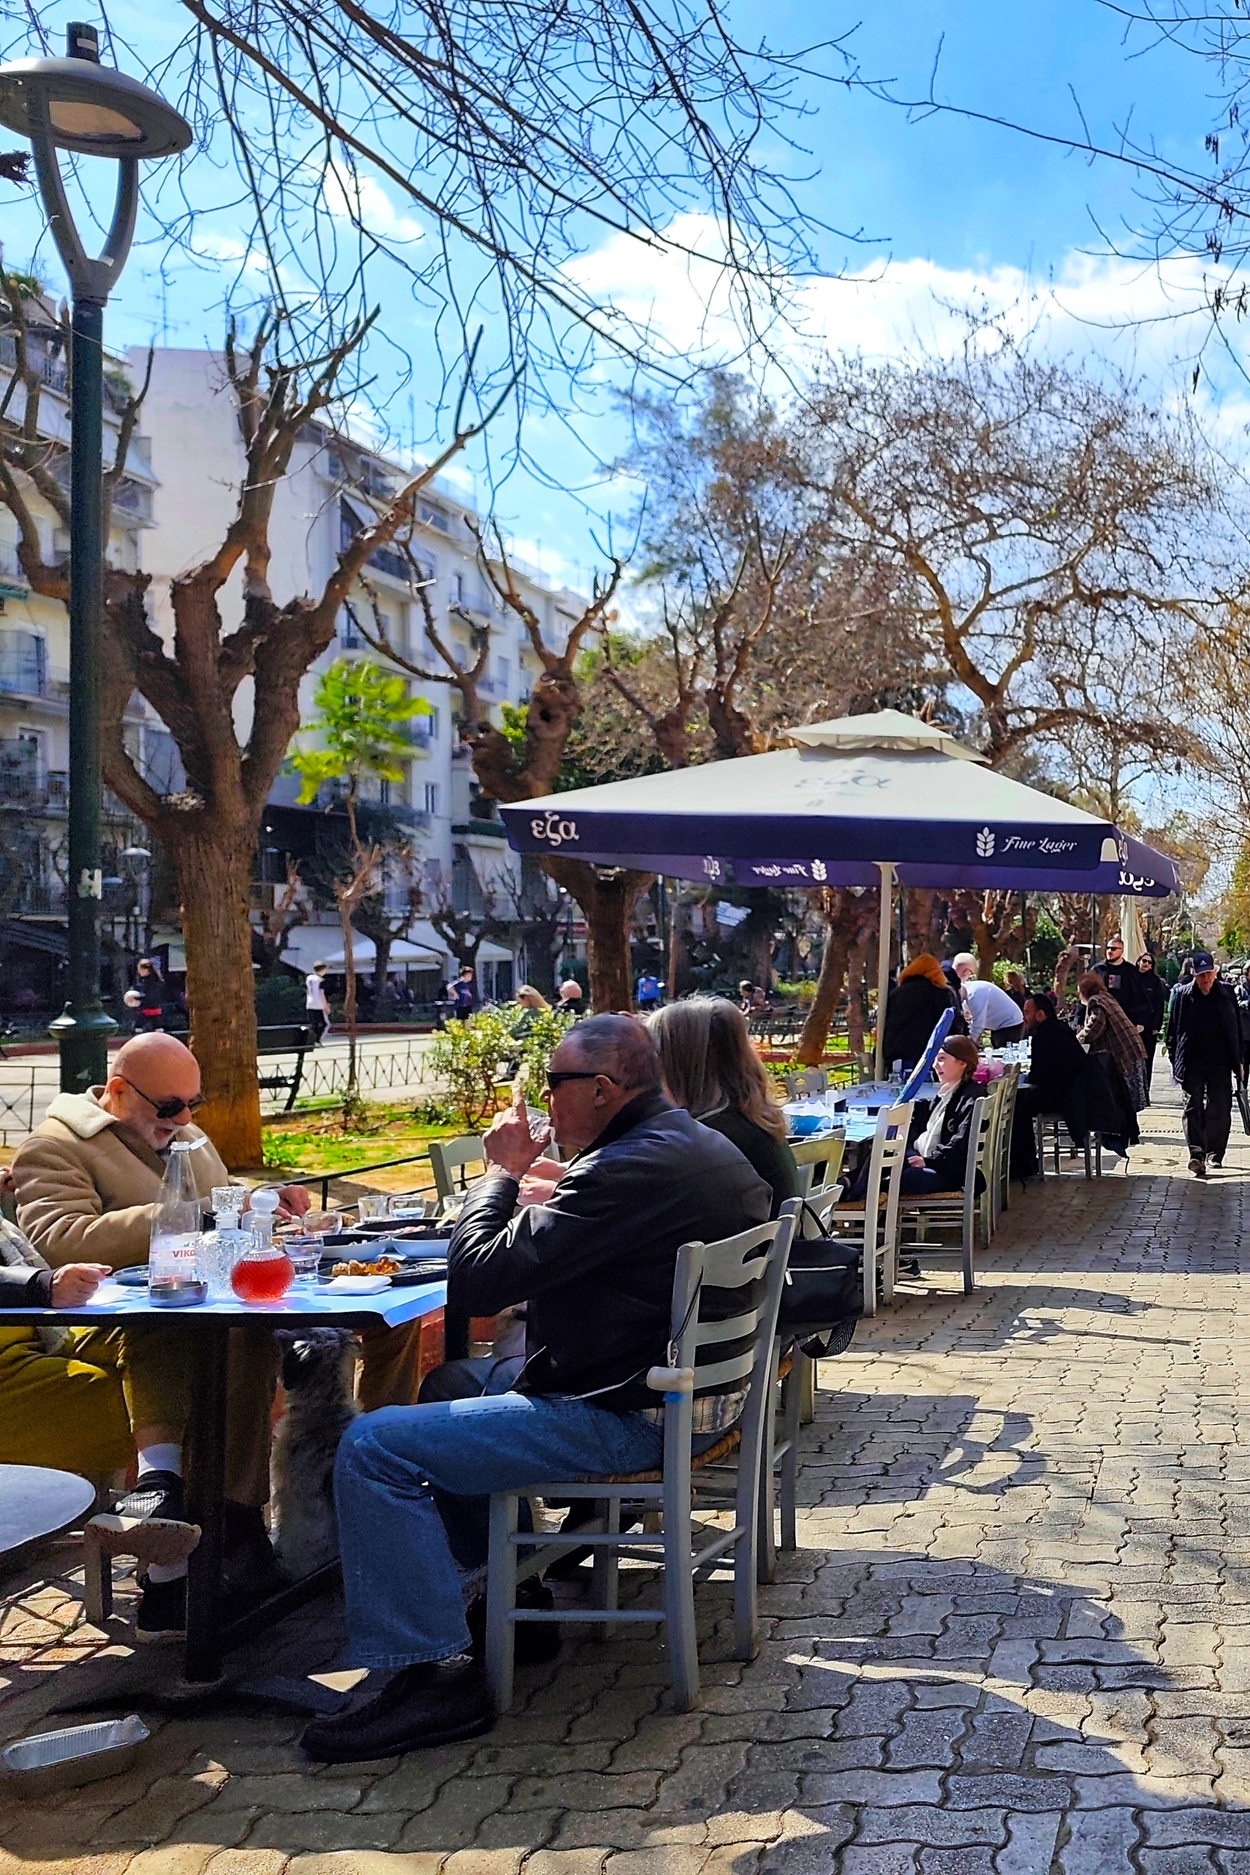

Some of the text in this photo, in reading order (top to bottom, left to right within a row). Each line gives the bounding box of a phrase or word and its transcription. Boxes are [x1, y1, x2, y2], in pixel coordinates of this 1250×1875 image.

[530, 810, 580, 847] εζα
[1001, 836, 1077, 853] Fine Lager
[172, 1250, 195, 1258] VIKO
